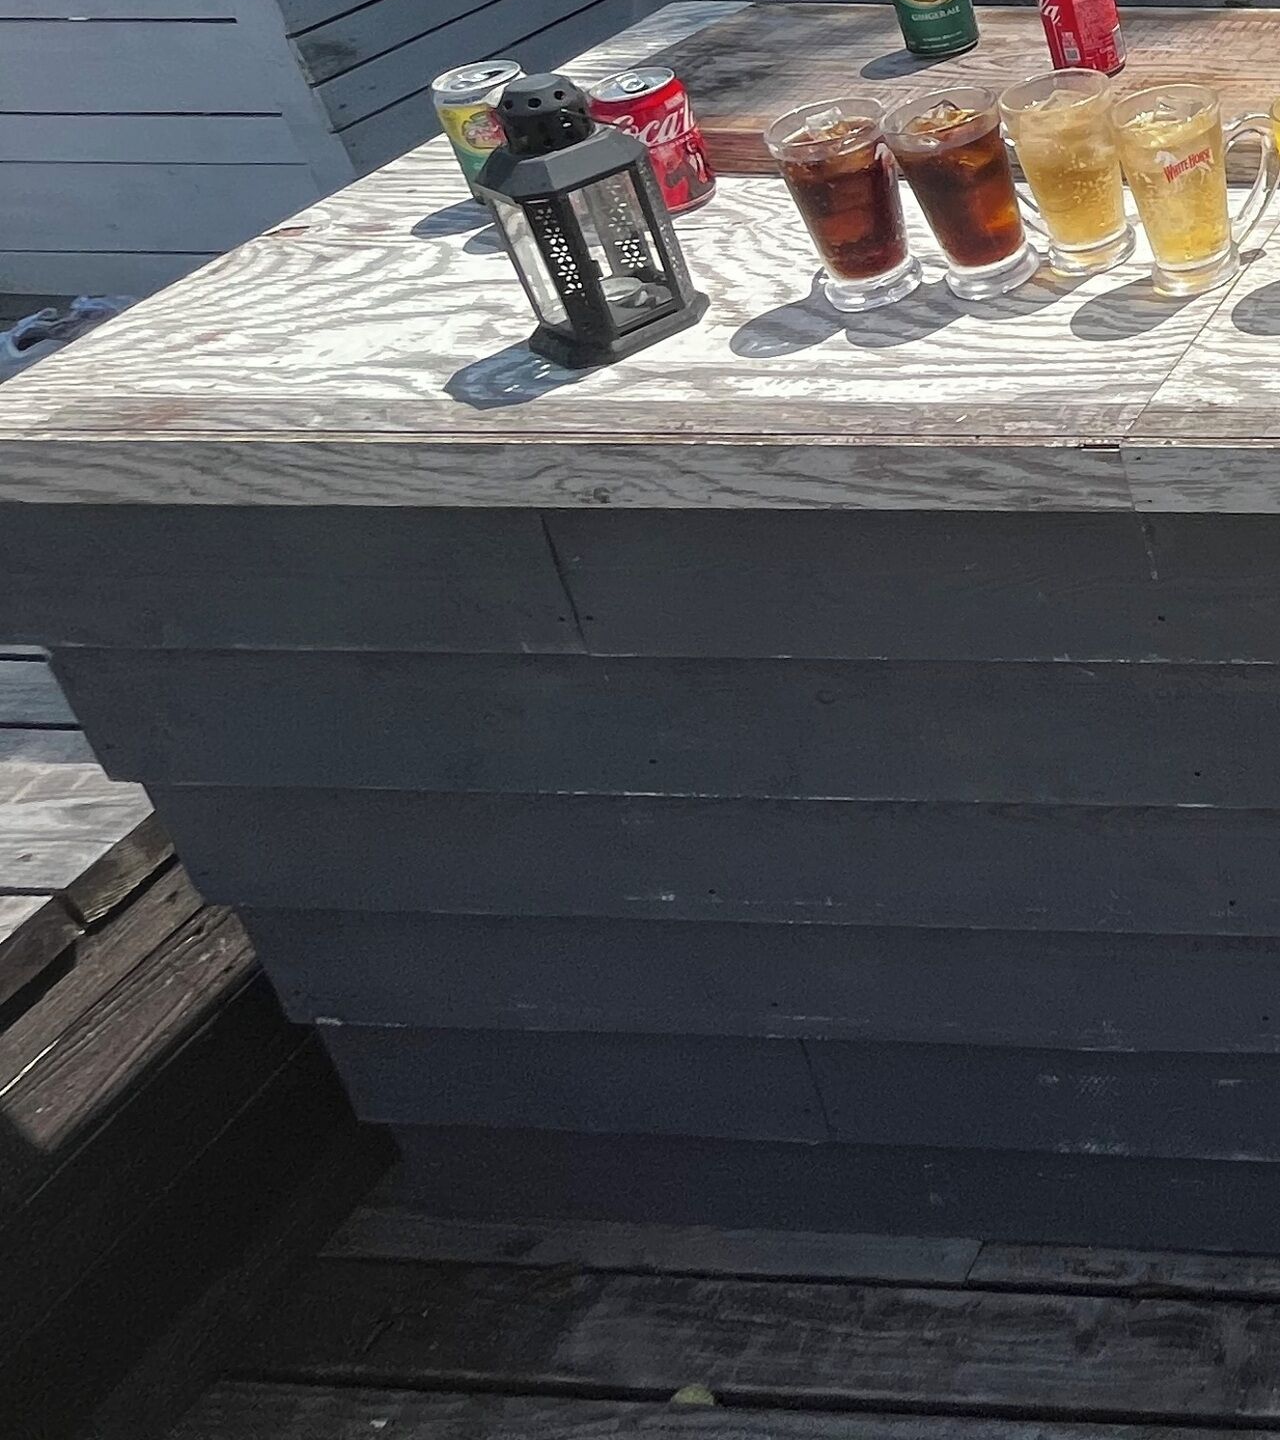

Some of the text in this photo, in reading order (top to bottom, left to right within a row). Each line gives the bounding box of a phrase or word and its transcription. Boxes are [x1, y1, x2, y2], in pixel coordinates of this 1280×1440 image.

[911, 5, 961, 21] GINGER ALE
[1163, 147, 1212, 184] WHITE HORSE
